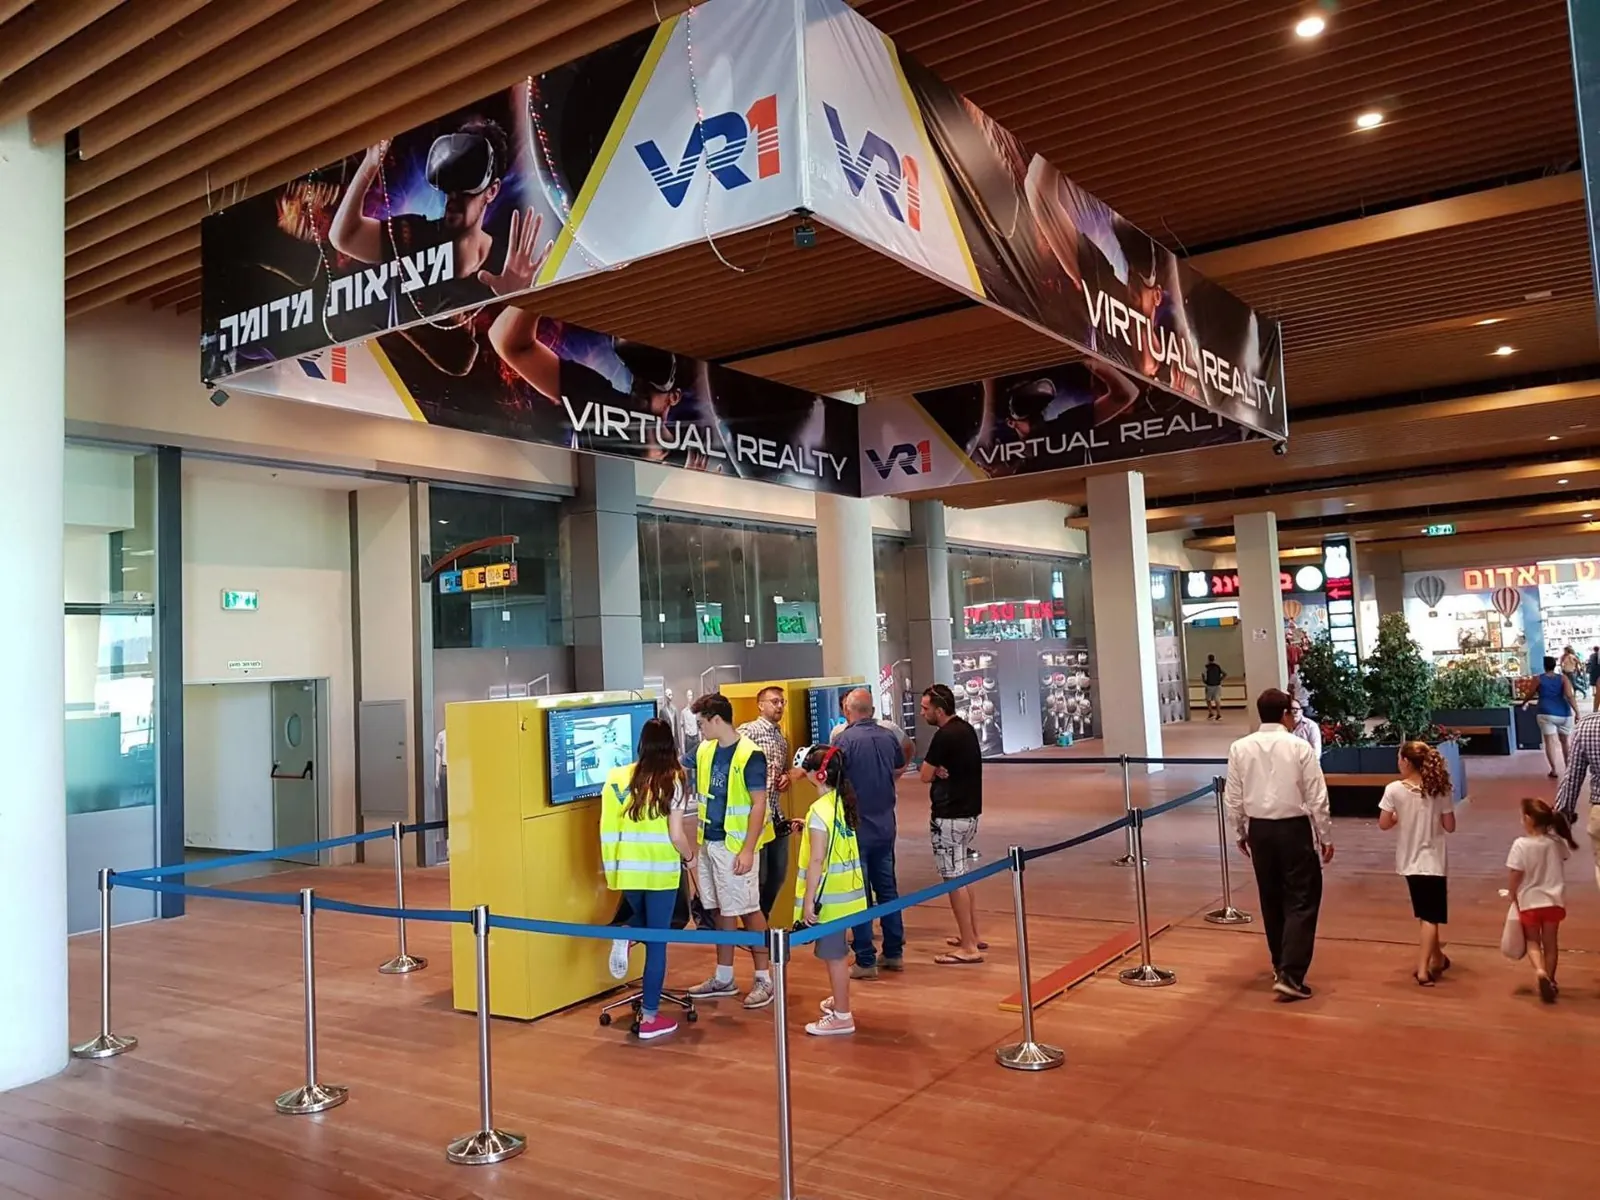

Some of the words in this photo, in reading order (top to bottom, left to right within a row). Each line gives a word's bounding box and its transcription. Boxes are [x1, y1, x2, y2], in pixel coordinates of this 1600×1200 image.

[634, 94, 780, 208] VR1
[823, 100, 920, 232] VR1
[327, 241, 454, 317] מציאות
[220, 288, 313, 350] מדומה
[1082, 279, 1198, 377] VIRTUAL
[1202, 349, 1276, 415] REALTY
[562, 396, 726, 459] VIRTUAL
[737, 434, 848, 480] REALTY
[866, 440, 931, 480] VR1
[979, 429, 1110, 464] VIRTUAL
[1120, 411, 1226, 443] REALT
[1464, 564, 1557, 590] האדום
